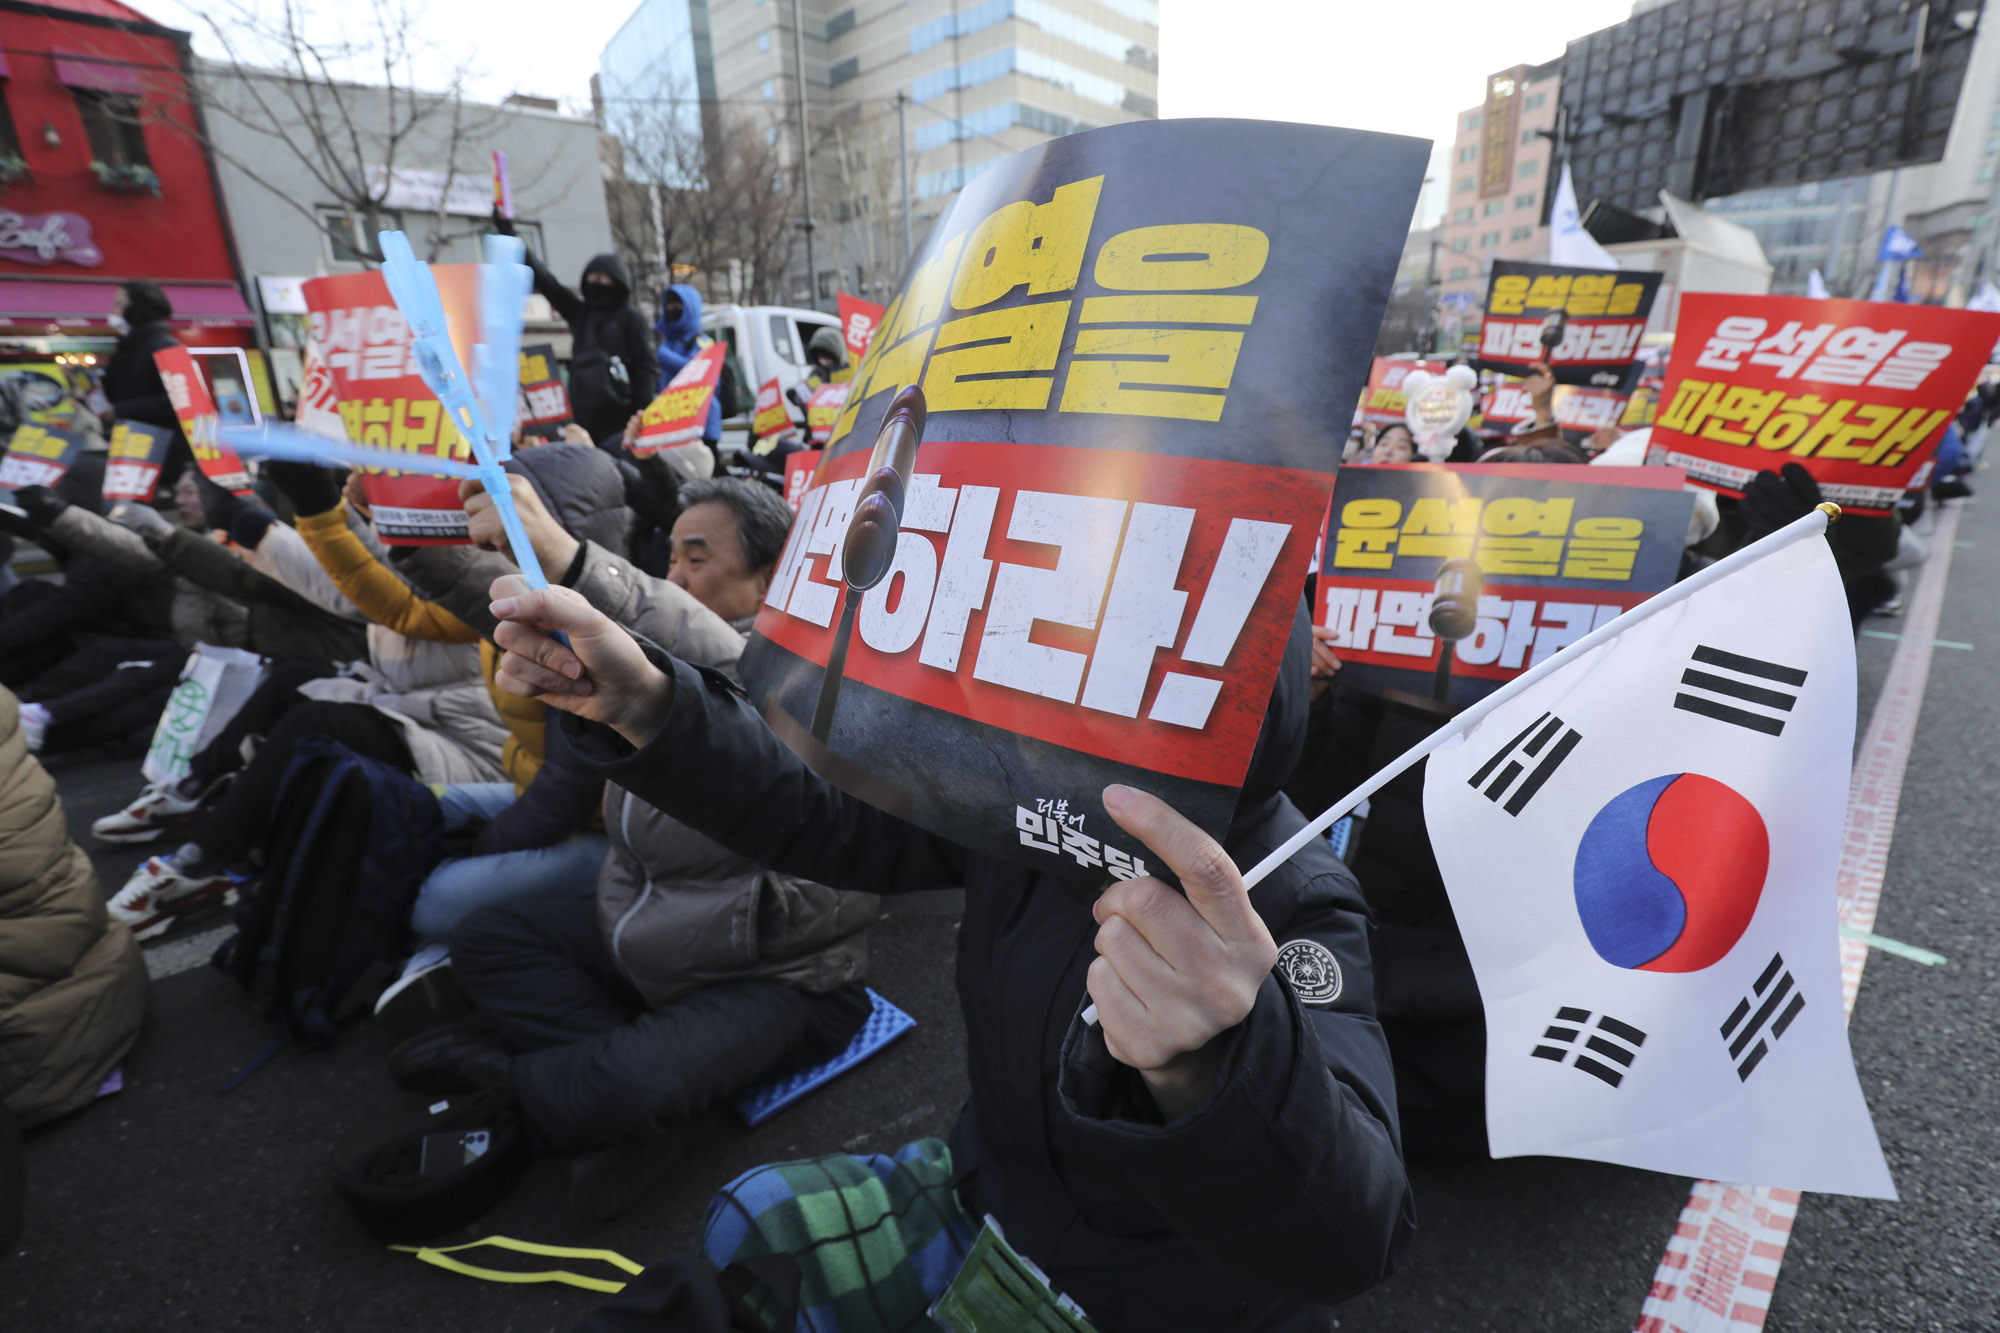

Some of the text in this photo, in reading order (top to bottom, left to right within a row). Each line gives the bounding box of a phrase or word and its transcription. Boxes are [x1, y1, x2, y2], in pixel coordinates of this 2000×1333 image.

[1488, 274, 1645, 316] 윤석열을
[1483, 321, 1644, 362] 파면하라!
[1695, 315, 1953, 391] 윤석열을
[1656, 378, 1951, 467] 파면하라!
[1333, 497, 1644, 581] 윤석열을
[1015, 804, 1151, 883] 민주당
[1035, 798, 1086, 833] 더불어
